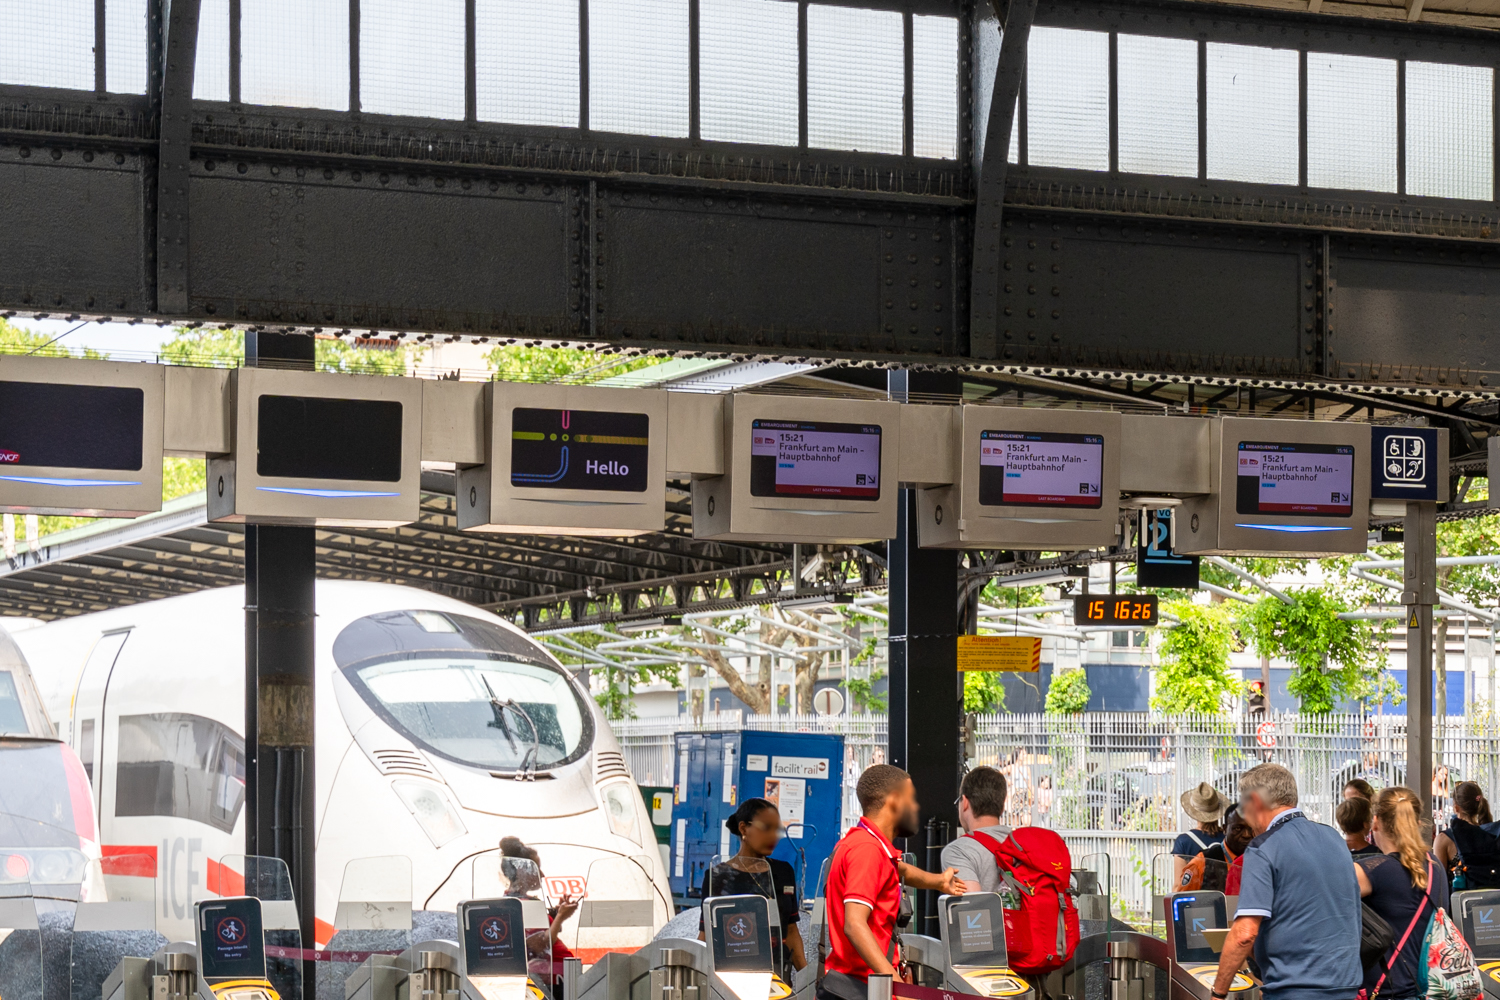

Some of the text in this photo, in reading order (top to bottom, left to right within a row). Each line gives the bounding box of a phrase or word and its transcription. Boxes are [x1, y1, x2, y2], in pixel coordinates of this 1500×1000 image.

[780, 433, 804, 442] 15:21
[780, 443, 819, 452] Frankfurt
[779, 452, 841, 462] Hauptbahnhof
[1006, 453, 1045, 462] Frankfurt
[586, 460, 629, 476] Hello
[1006, 462, 1065, 472] Hauptbahnhof
[1262, 463, 1298, 472] Frankfurt
[1262, 472, 1318, 481] Hauptbahnhof
[1088, 601, 1151, 619] 15 16 26
[162, 837, 202, 920] ICE
[551, 880, 583, 895] DB
